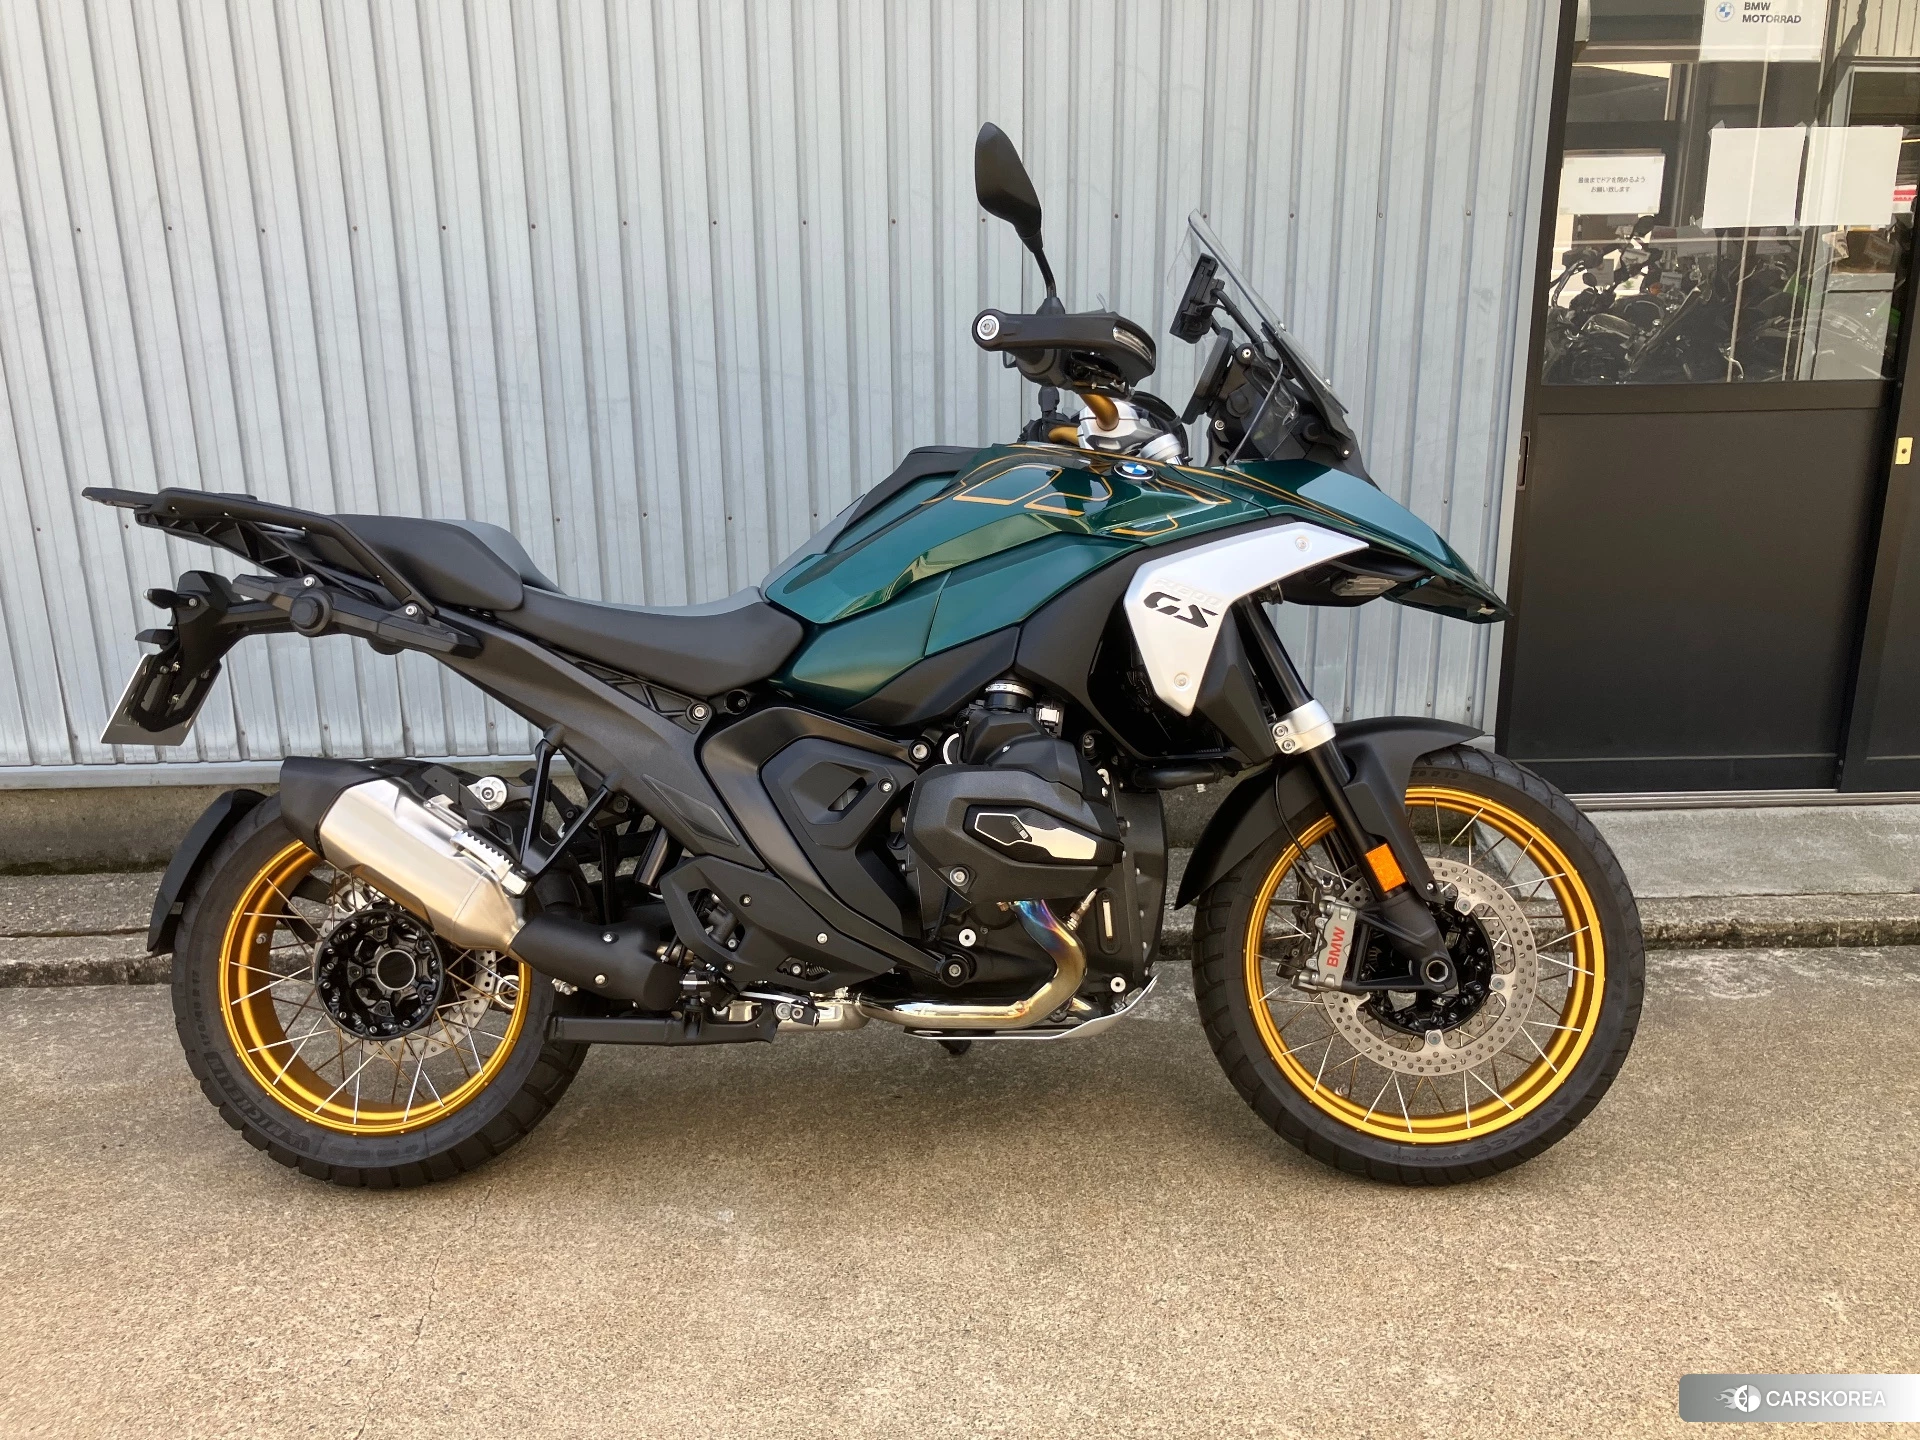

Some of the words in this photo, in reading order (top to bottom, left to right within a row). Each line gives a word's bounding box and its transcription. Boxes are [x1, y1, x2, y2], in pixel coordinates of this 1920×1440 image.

[1742, 14, 1802, 24] MOTORRAD
[1744, 2, 1771, 11] BMW
[1143, 592, 1219, 629] GS
[1326, 925, 1346, 968] BMW
[208, 1056, 286, 1138] MICHELIN
[1473, 1094, 1573, 1157] ANAKEE
